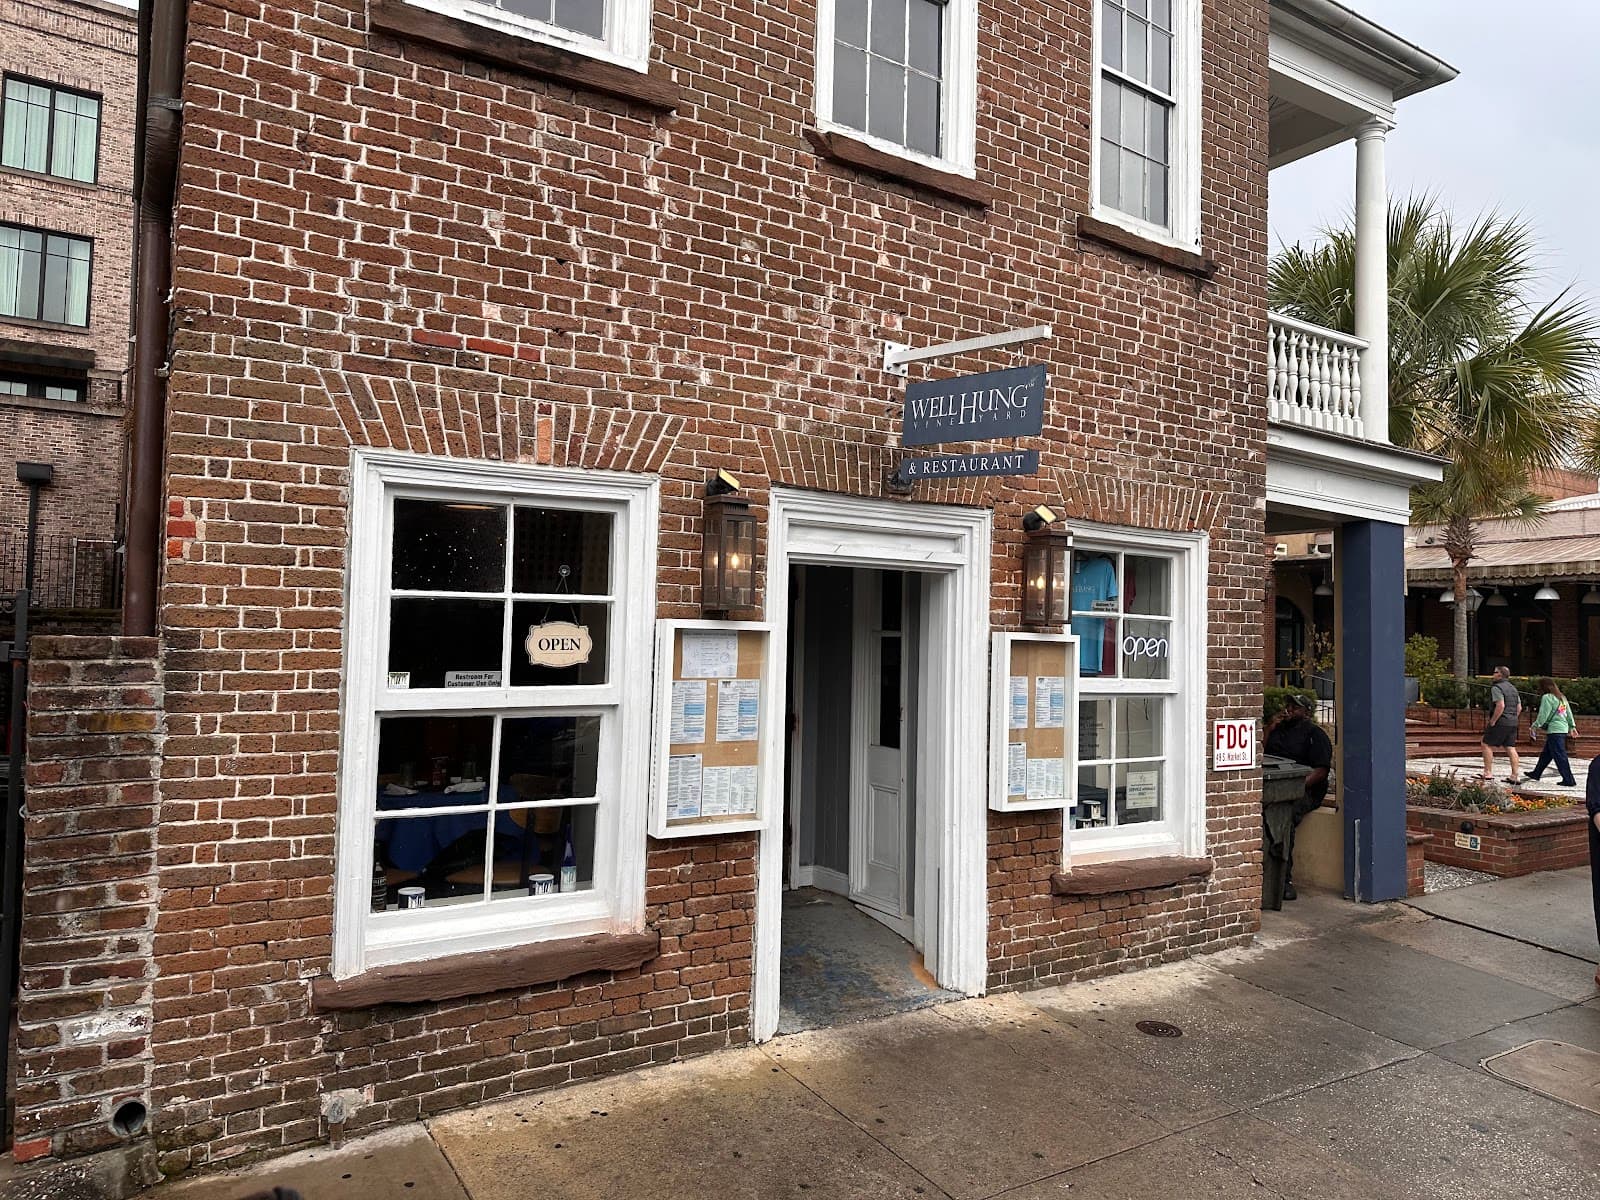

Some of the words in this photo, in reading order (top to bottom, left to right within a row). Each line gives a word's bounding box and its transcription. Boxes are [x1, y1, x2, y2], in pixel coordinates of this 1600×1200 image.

[912, 409, 1027, 431] VINEYARD
[908, 462, 917, 475] &
[923, 455, 1025, 474] RESTAURANT
[538, 637, 582, 651] OPEN
[1123, 635, 1169, 662] open
[1216, 724, 1247, 749] FDC
